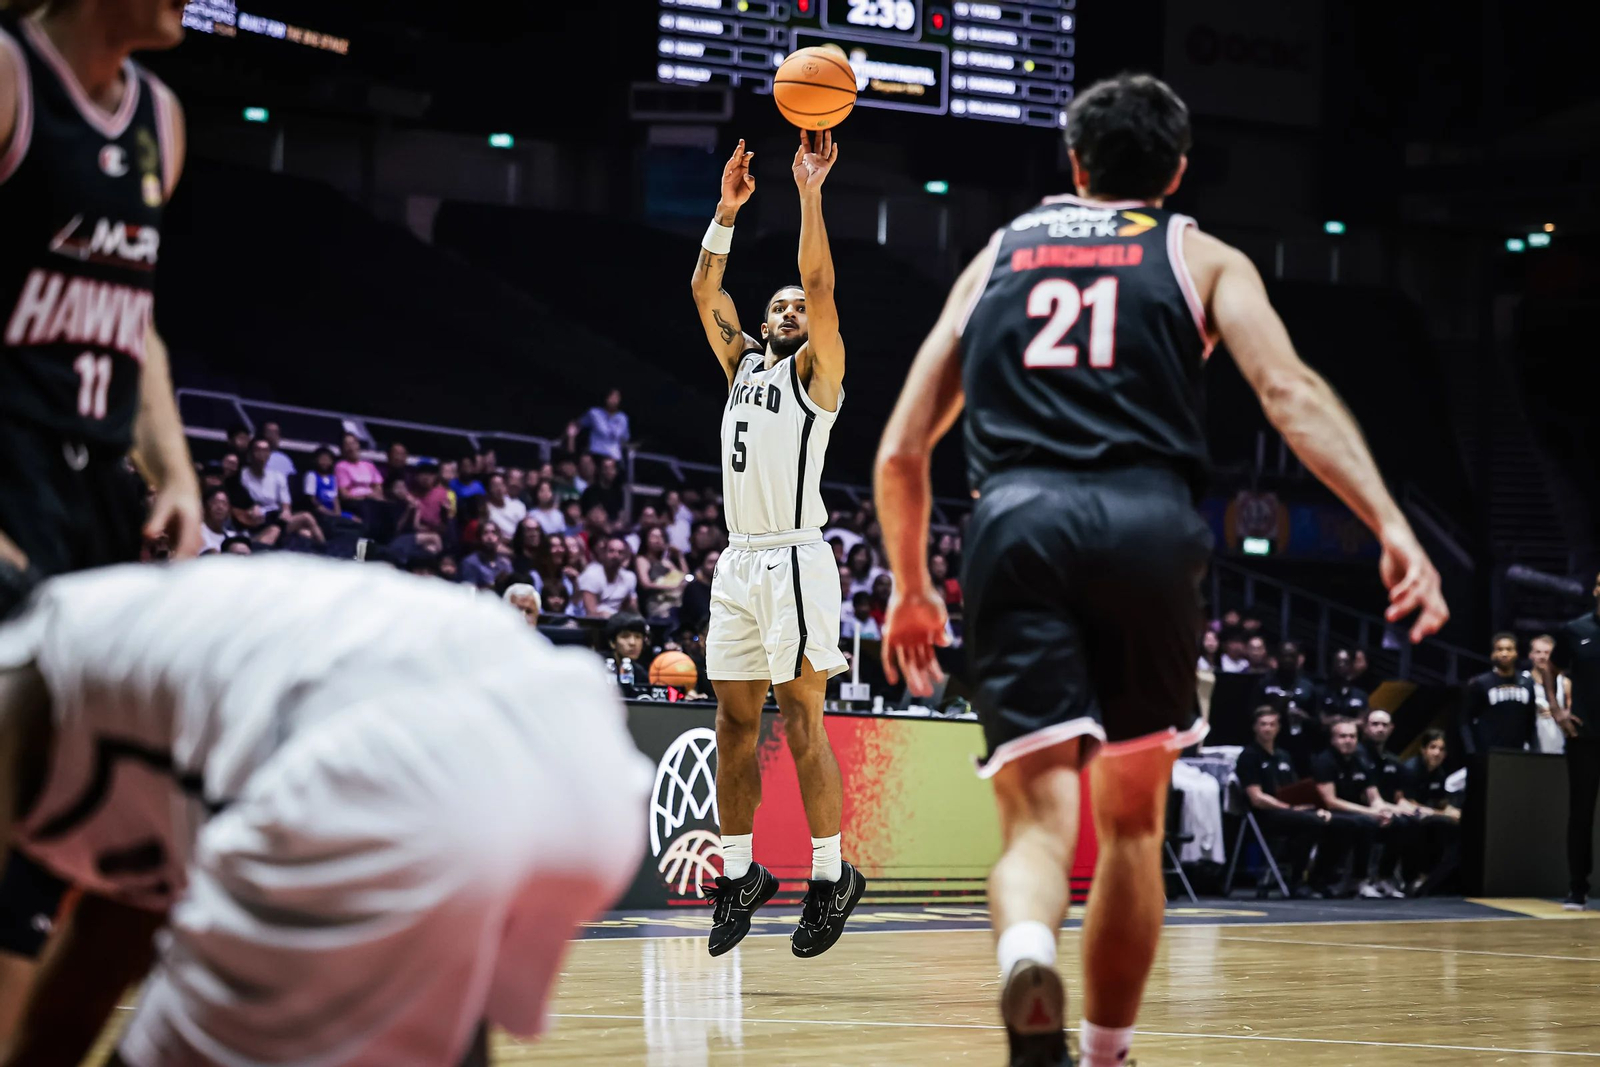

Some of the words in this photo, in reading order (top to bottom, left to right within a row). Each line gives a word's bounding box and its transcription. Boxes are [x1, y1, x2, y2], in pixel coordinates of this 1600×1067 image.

[847, 0, 915, 30] 2:39
[4, 268, 154, 364] HAWK
[1023, 275, 1119, 369] 21
[73, 352, 111, 419] 11
[731, 421, 749, 473] 5
